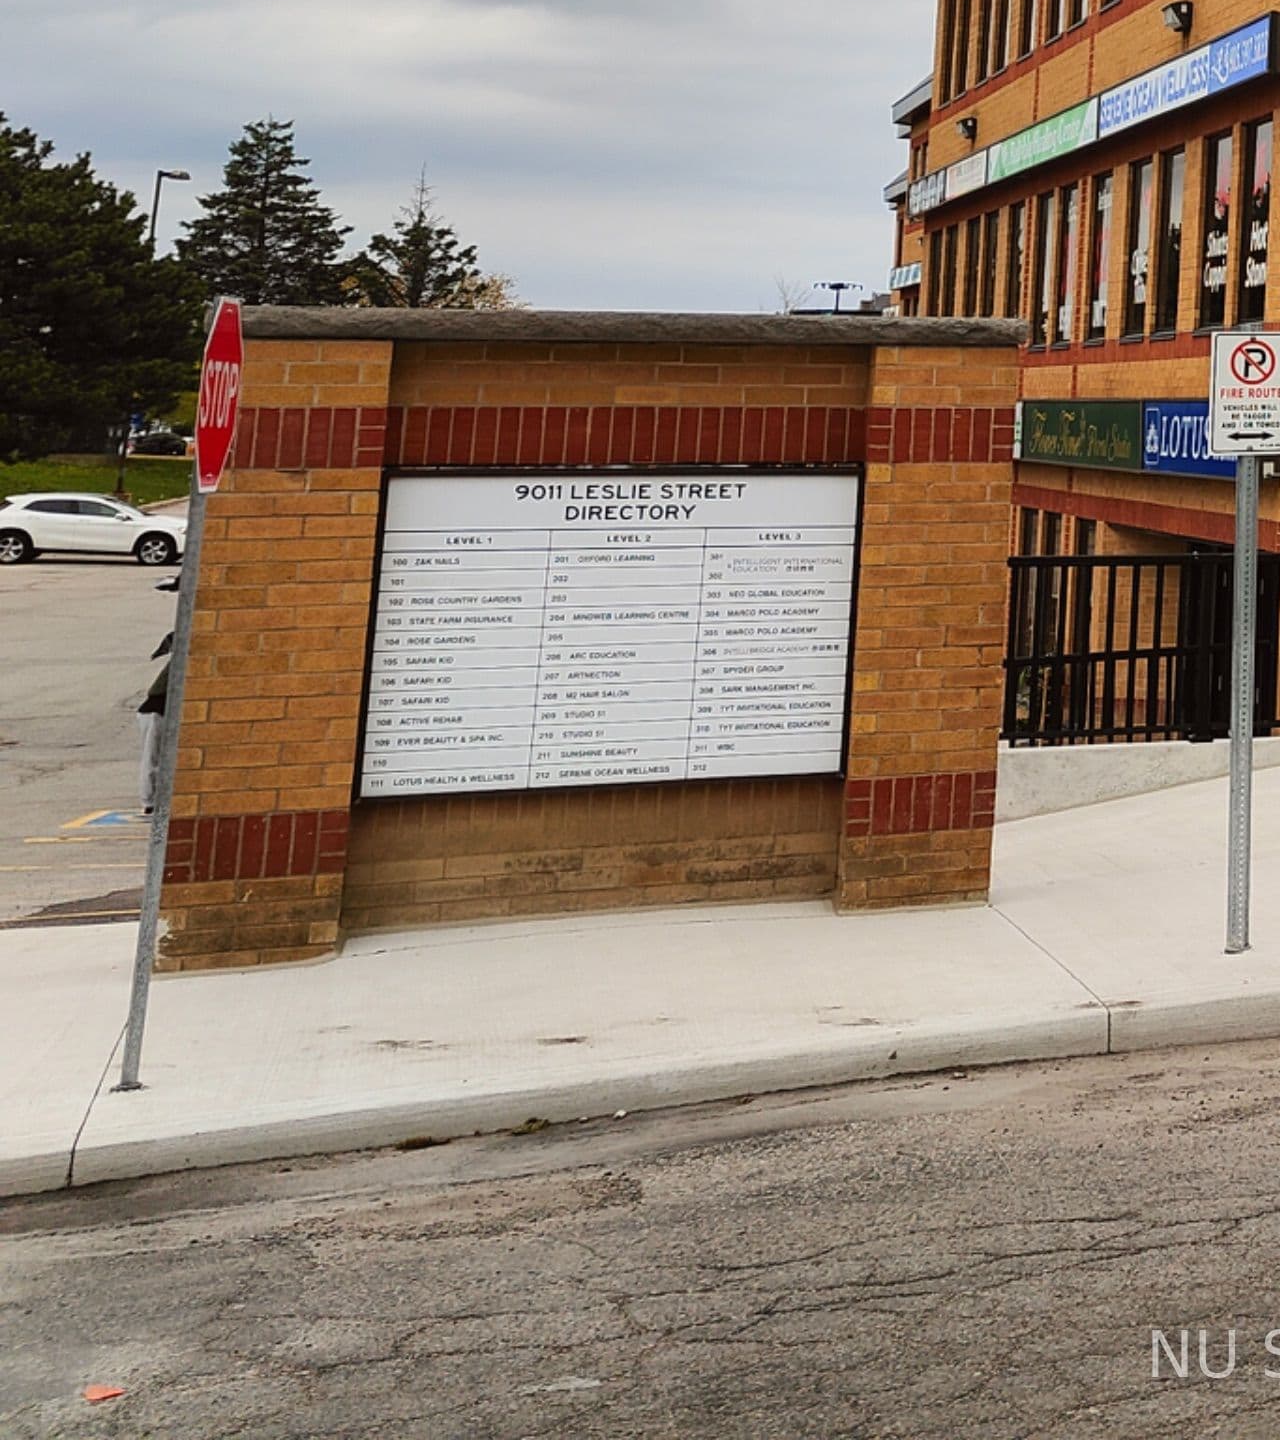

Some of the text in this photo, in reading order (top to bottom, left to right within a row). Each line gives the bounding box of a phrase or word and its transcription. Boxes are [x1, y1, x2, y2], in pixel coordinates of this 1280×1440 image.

[201, 359, 239, 429] STOP
[1220, 388, 1243, 398] FIRE
[1159, 416, 1210, 460] LOTUS
[514, 483, 747, 500] 9011 LESLIE STREET
[565, 504, 696, 522] DIRECTORY
[445, 536, 494, 546] LEVEL 1
[606, 534, 652, 544] LEVEL 2
[758, 532, 791, 542] LEVEL
[746, 589, 779, 598] GLOBAL
[780, 588, 826, 598] EDUCATION
[437, 595, 479, 605] COUNTRY
[480, 595, 523, 604] GARDENS
[613, 611, 657, 621] LEARNING
[657, 610, 690, 620] CENTRE
[780, 607, 820, 617] ACADEMY
[408, 614, 513, 626] STATE FARM INSURANCE
[779, 626, 819, 635] ACADEMY
[432, 635, 476, 645] GARDENS
[588, 650, 637, 660] EDUCATION
[755, 664, 785, 674] GROUP
[744, 683, 800, 693] MANAGEMENT
[788, 700, 832, 710] EDUCATION
[398, 716, 430, 726] ACTIVE
[422, 735, 458, 746] BEAUTY
[604, 747, 639, 757] BEAUTY
[593, 767, 625, 778] OCEAN
[625, 765, 671, 775] WELLNESS
[392, 777, 423, 788] LOTUS
[424, 775, 459, 786] HEALTH
[468, 773, 516, 784] WELLNESS
